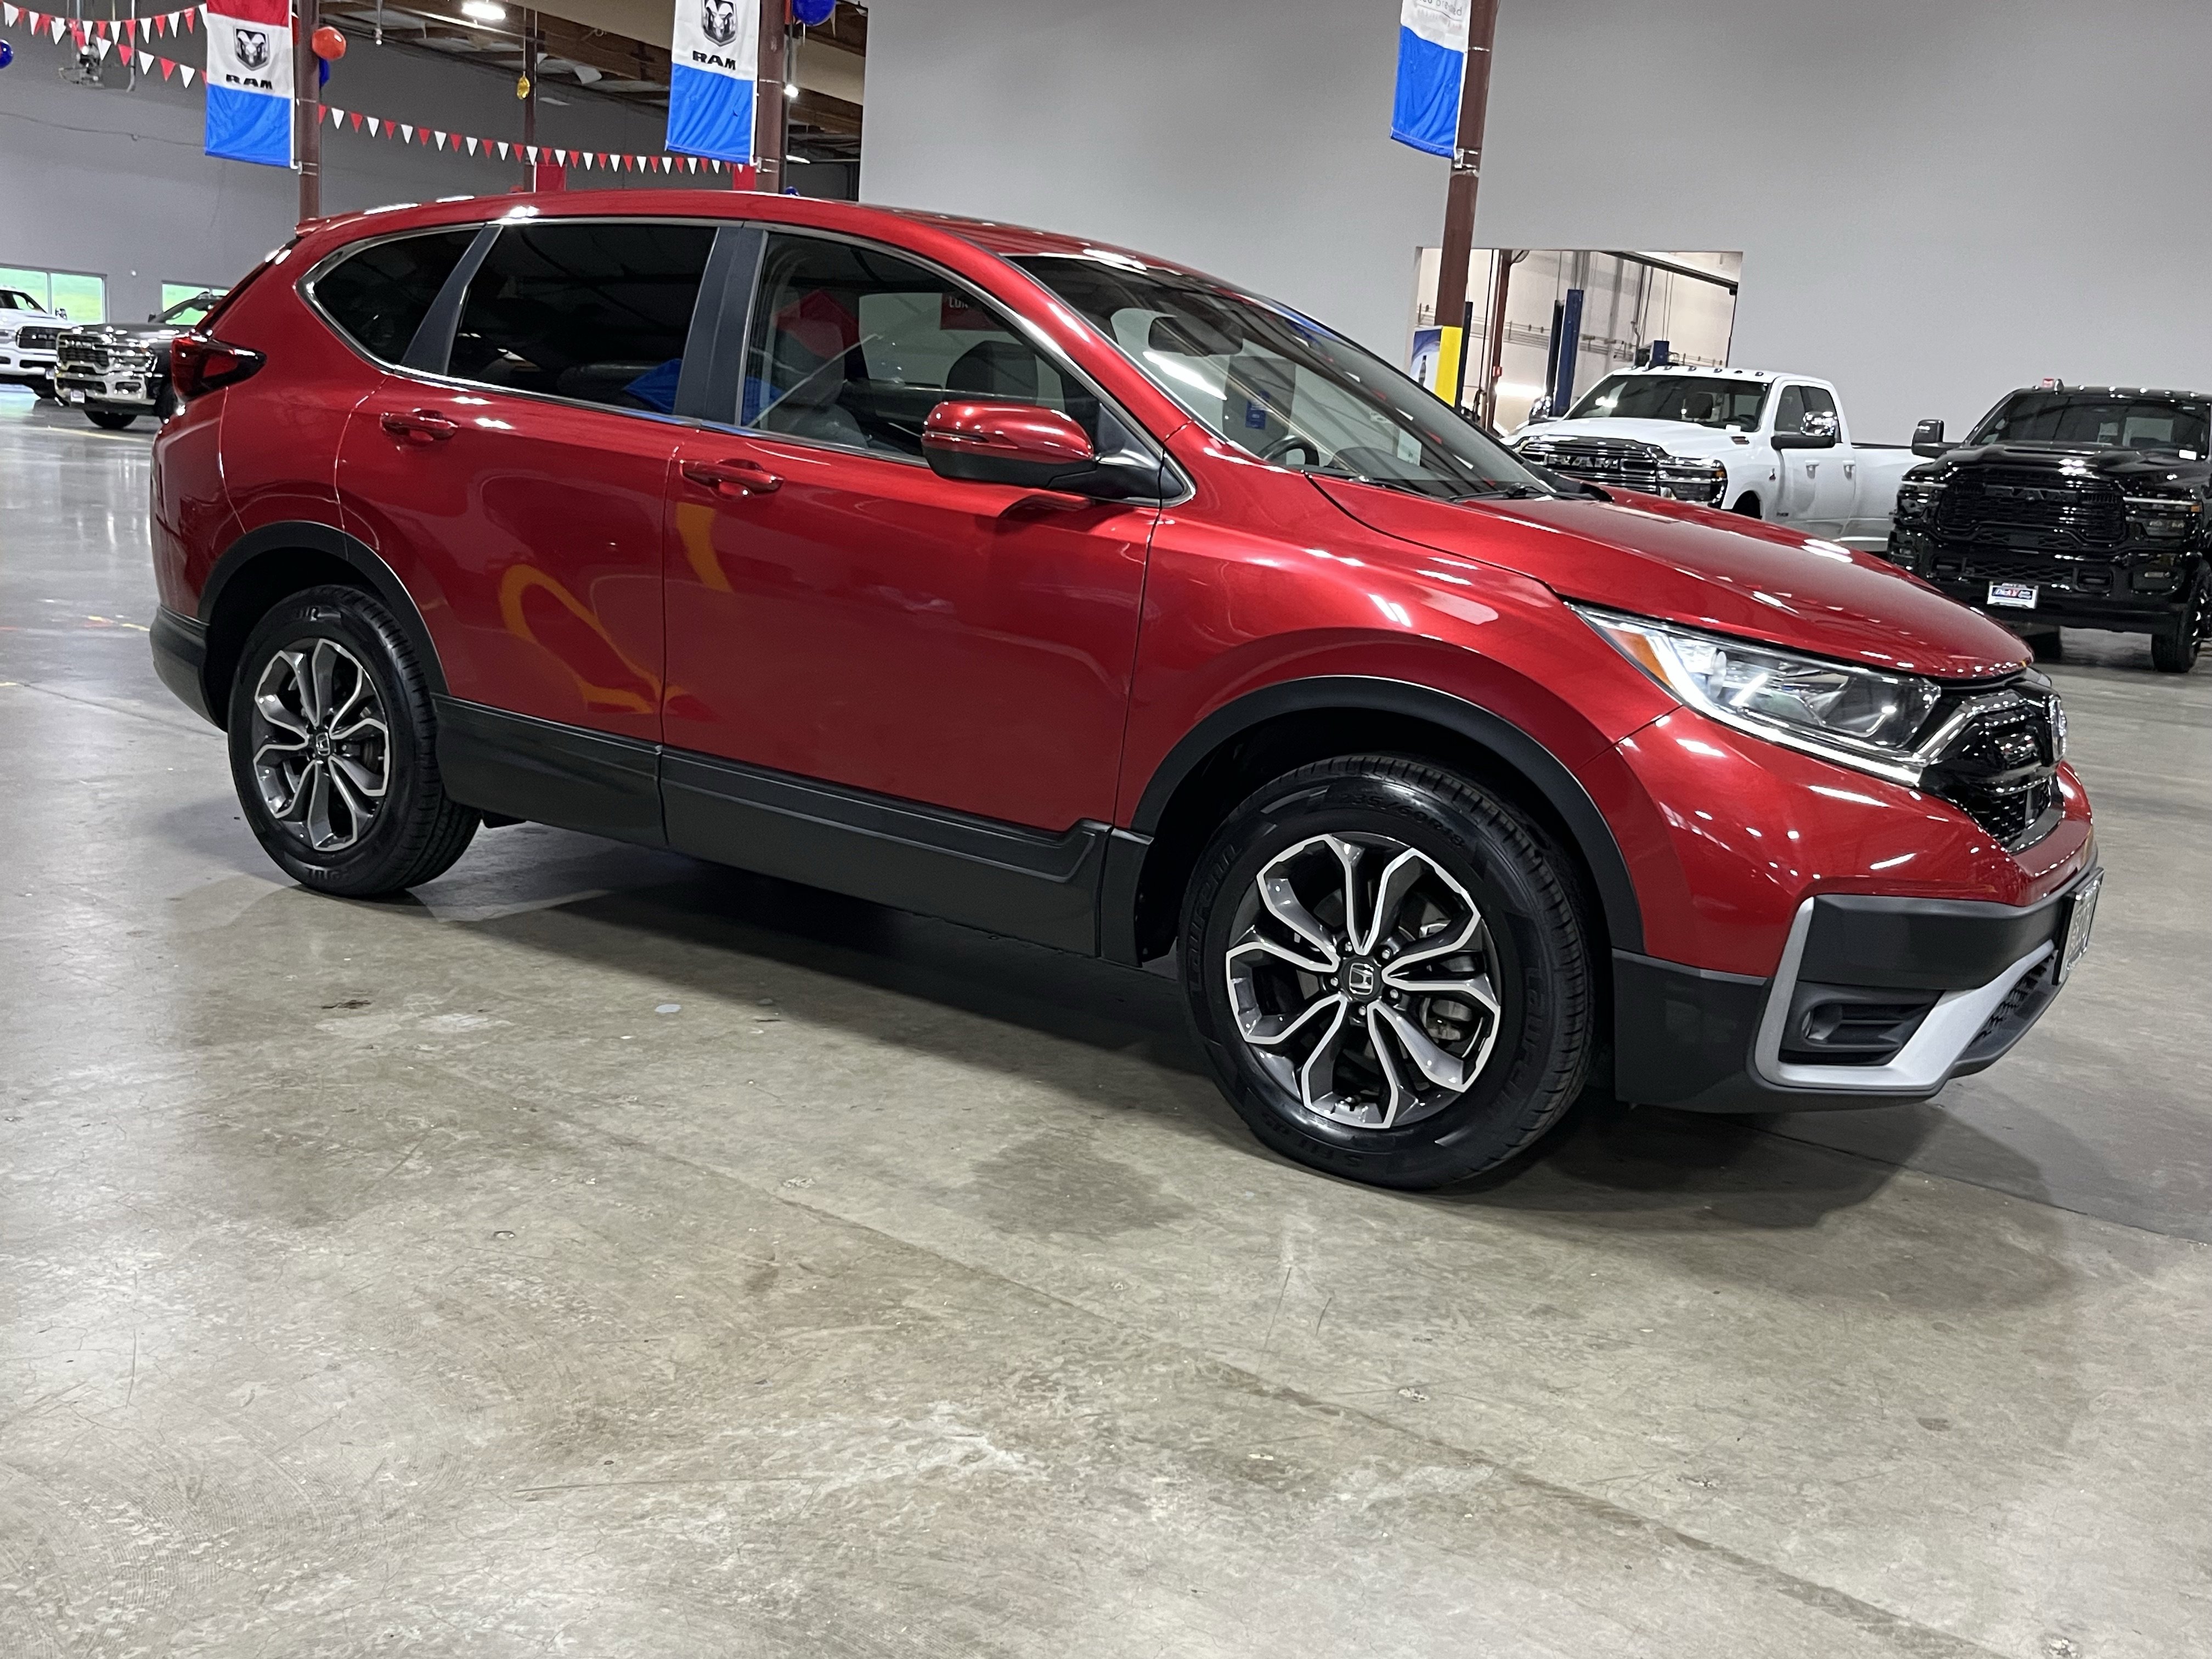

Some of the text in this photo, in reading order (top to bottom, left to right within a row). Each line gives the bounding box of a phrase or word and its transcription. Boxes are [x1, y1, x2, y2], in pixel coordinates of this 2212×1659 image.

[692, 50, 736, 70] RAM
[225, 74, 273, 90] RAM
[1547, 455, 1618, 469] RAM
